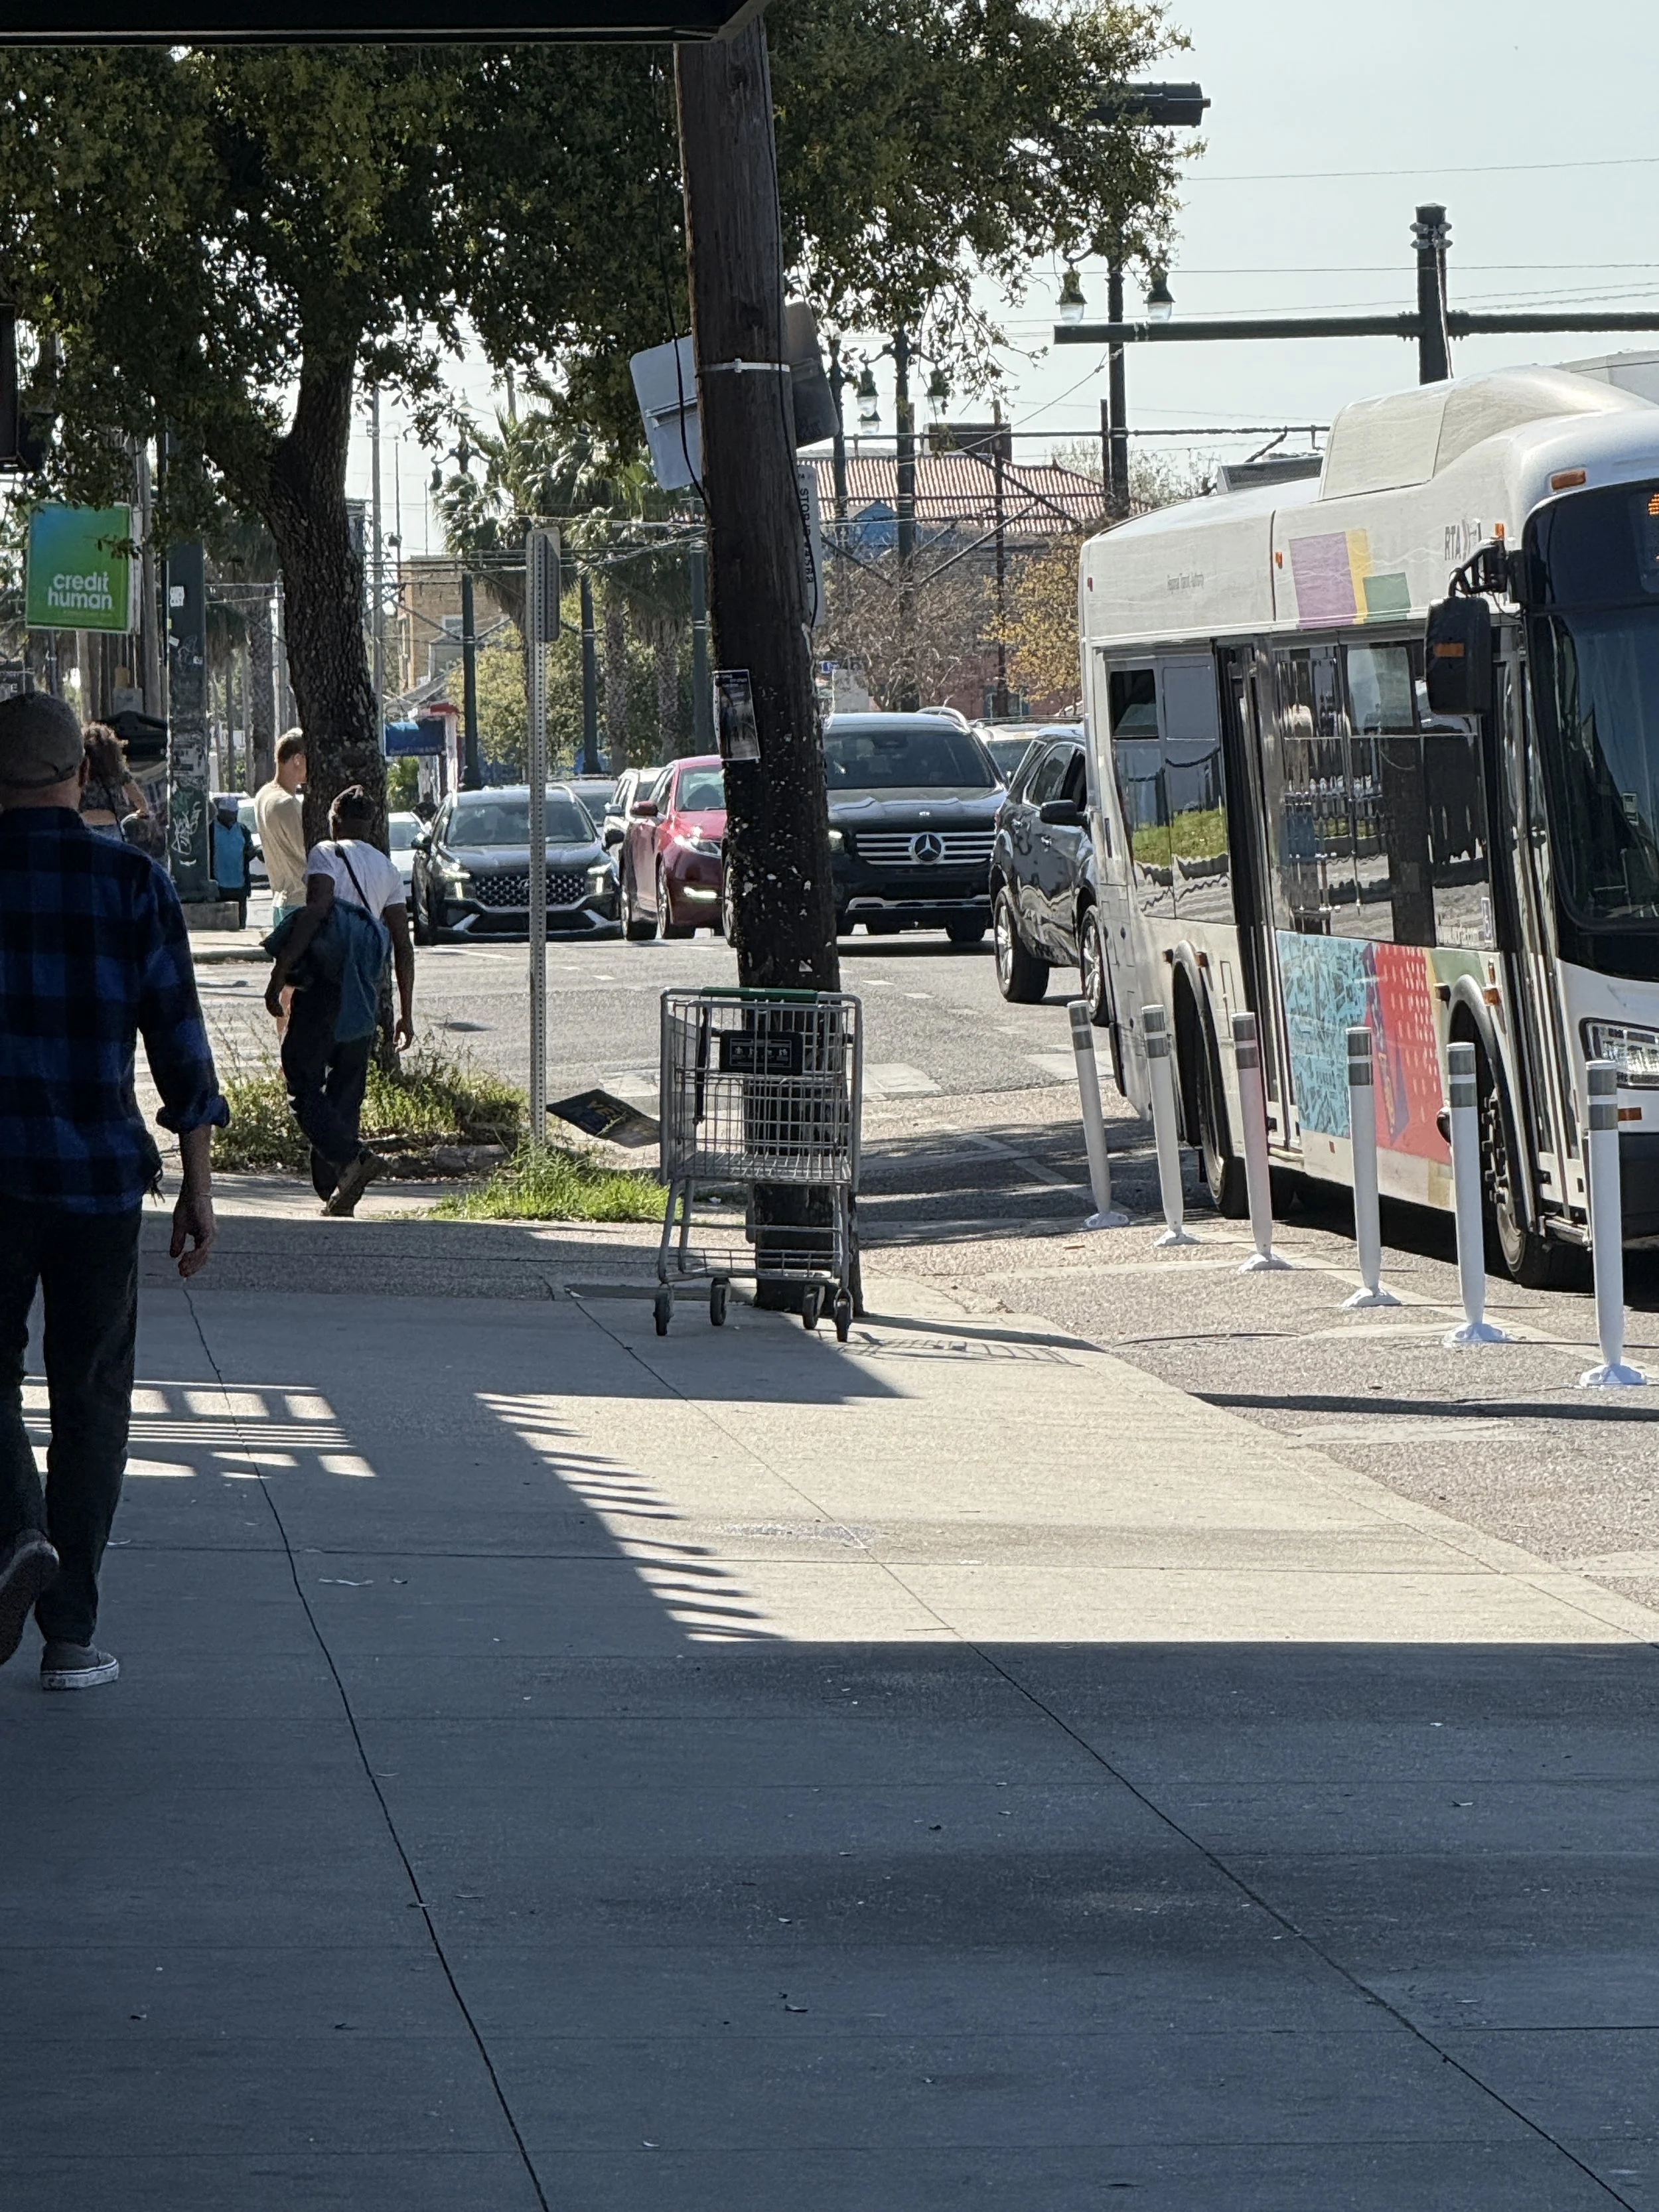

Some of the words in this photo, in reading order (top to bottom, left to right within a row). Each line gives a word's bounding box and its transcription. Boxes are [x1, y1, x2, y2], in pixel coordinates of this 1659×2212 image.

[1445, 524, 1461, 561] RTA
[53, 571, 109, 592] credit
[48, 587, 112, 611] human
